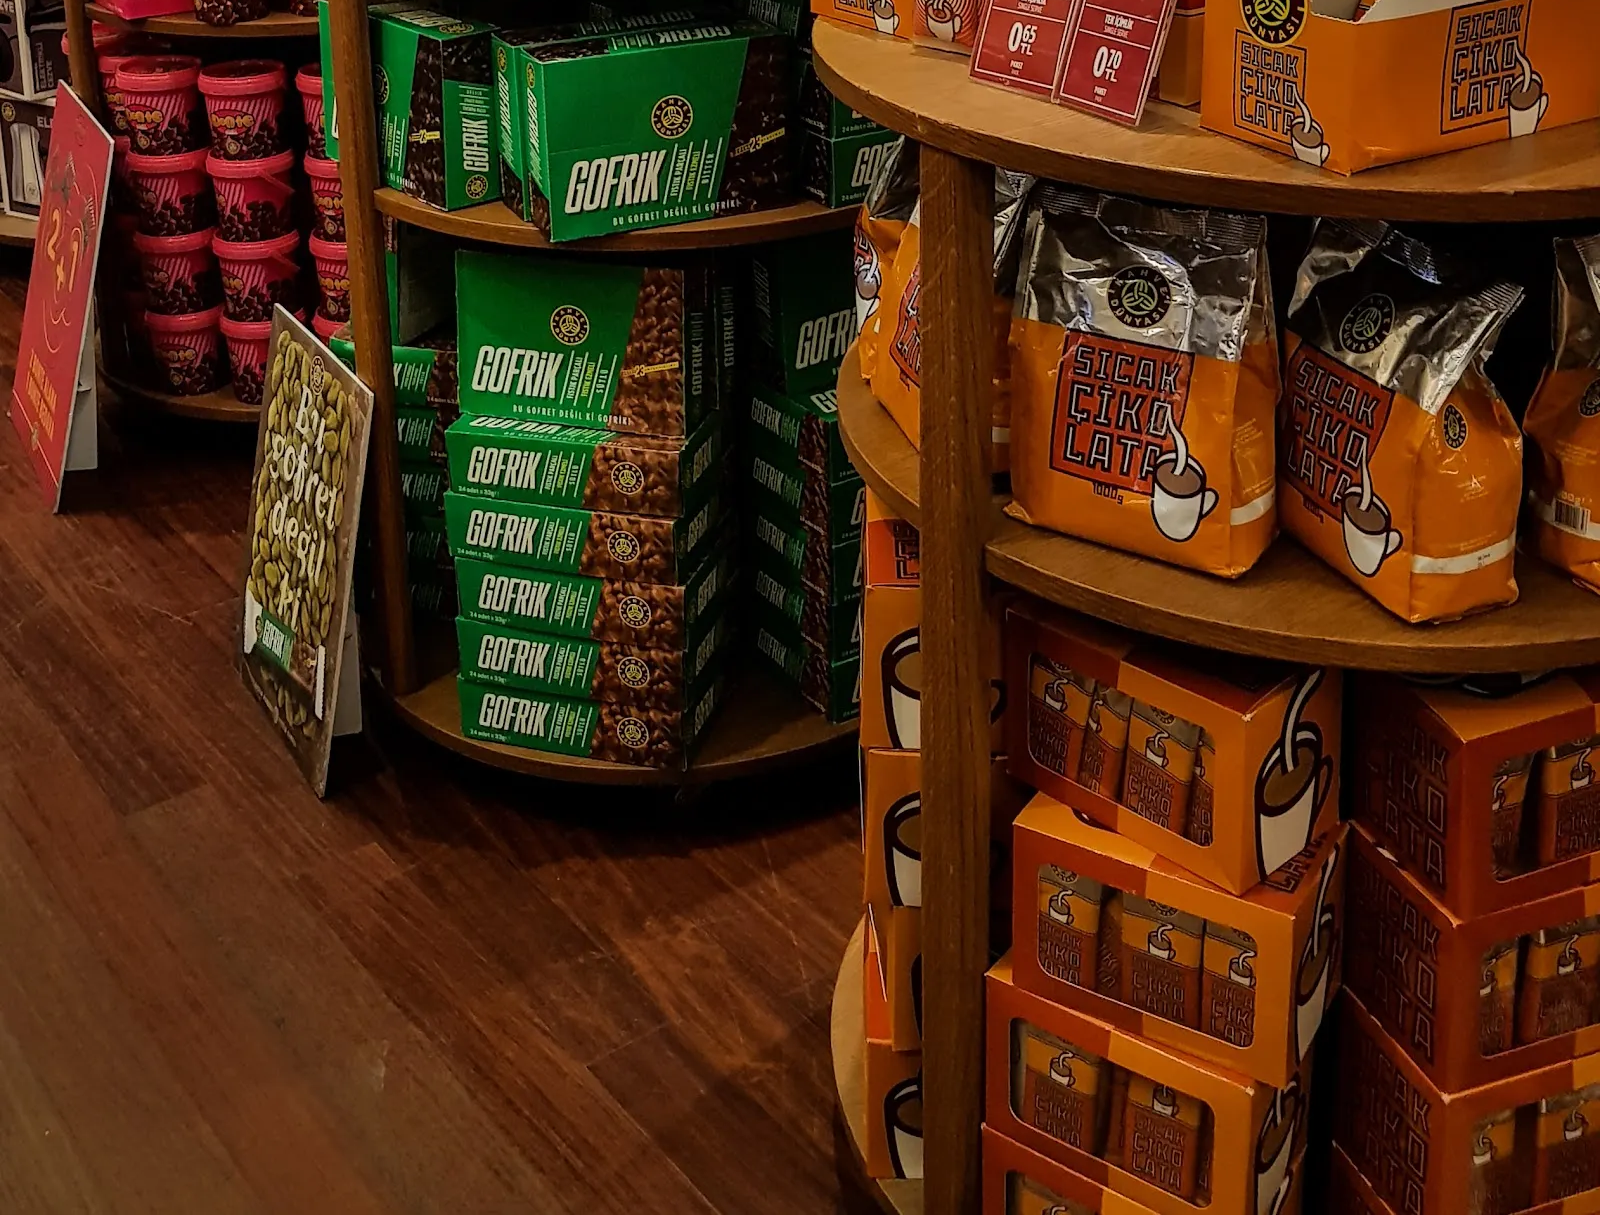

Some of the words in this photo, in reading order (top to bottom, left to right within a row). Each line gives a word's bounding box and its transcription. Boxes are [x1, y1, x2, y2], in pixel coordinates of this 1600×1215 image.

[1243, 5, 1299, 42] DÜNYASI
[1455, 4, 1524, 45] SICAK
[1020, 42, 1033, 56] TL
[1240, 42, 1299, 79] SICAK
[1105, 69, 1118, 83] TL
[613, 216, 624, 226] BU
[628, 211, 660, 223] GOFRET
[663, 206, 689, 218] DEĞİL
[1111, 298, 1168, 327] DÜNYASI
[1073, 344, 1182, 395] SICAK
[513, 404, 522, 413] BU
[527, 406, 556, 417] GOFRET
[558, 408, 583, 420] DEĞİL
[1068, 383, 1172, 438] ÇİKO
[1295, 359, 1379, 431] SICAK
[295, 385, 326, 454] Bu
[269, 434, 337, 531] gofret
